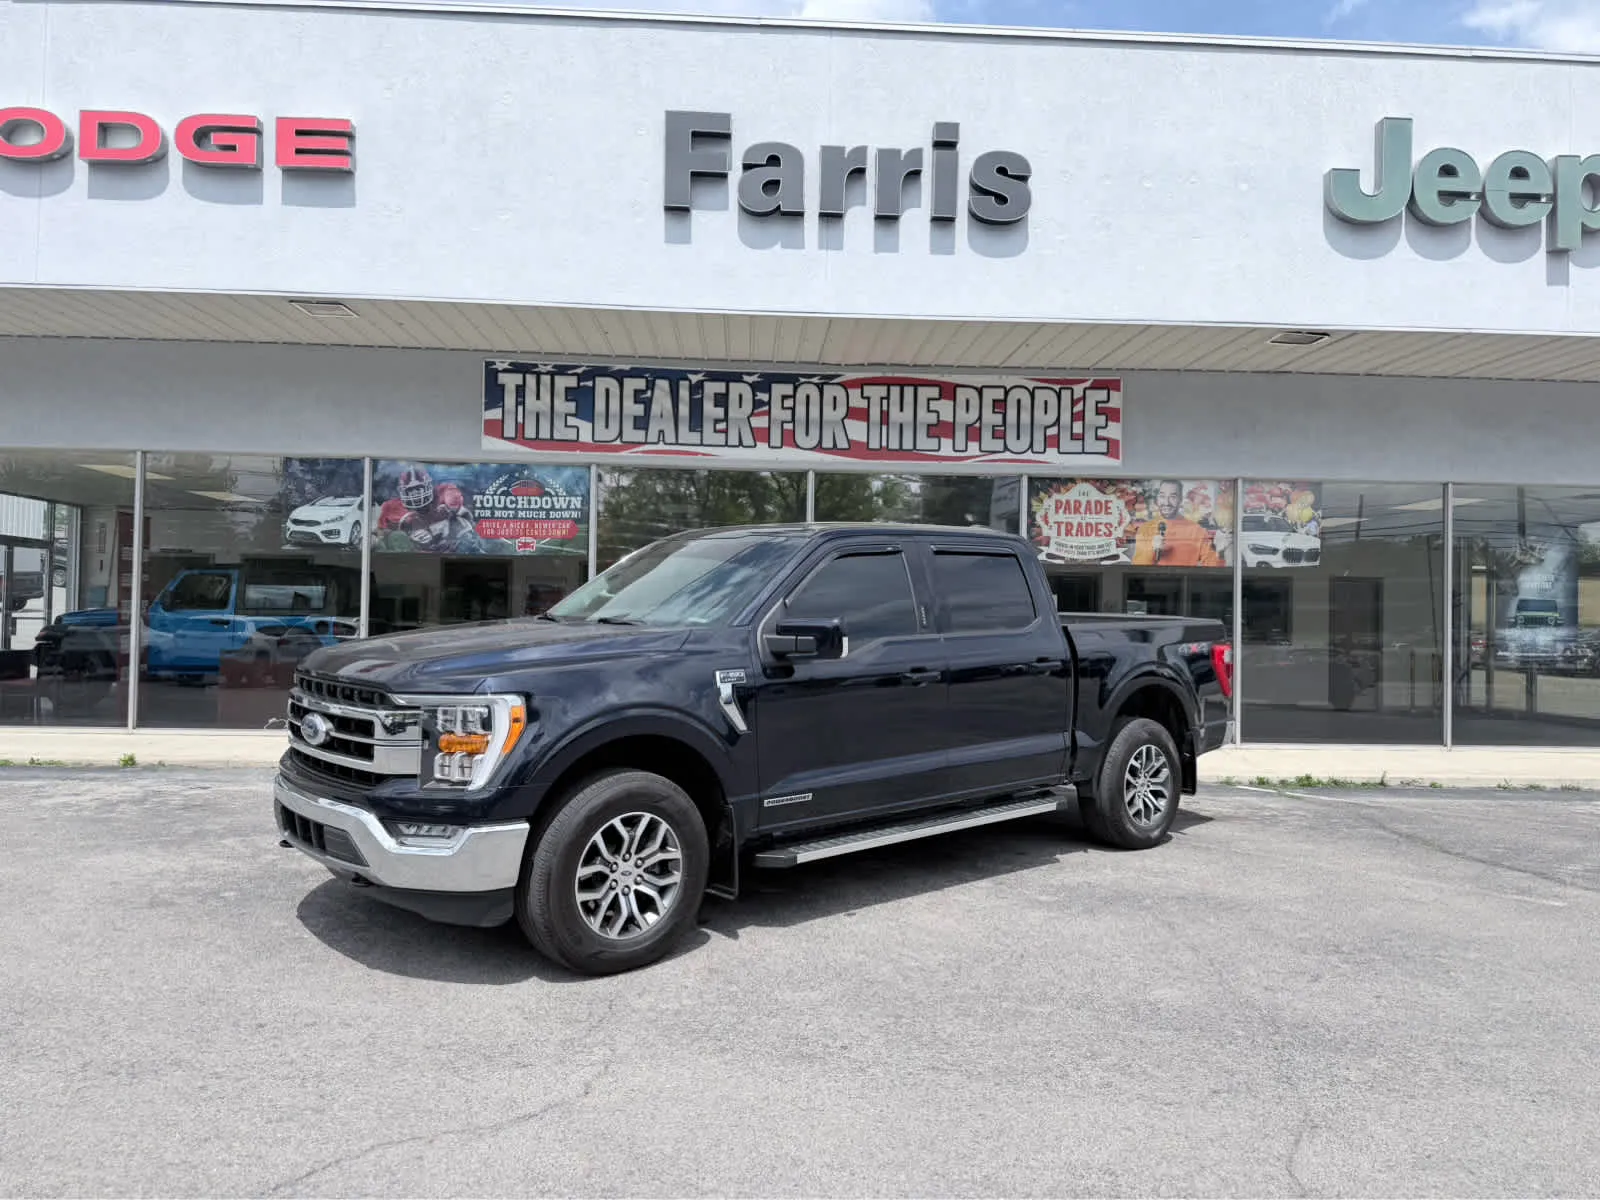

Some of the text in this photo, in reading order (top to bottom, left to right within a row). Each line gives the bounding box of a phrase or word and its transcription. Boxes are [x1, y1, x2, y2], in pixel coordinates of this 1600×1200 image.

[664, 110, 1032, 224] Farris
[1323, 117, 1600, 251] Jeep
[497, 373, 1111, 455] THE DEALER FOR THE PEOPLE
[472, 494, 583, 509] TOUCHDOWN
[1054, 499, 1113, 515] PARADE
[474, 509, 581, 519] FOR NOT MUCH DOWN!
[1053, 521, 1114, 538] TRADES
